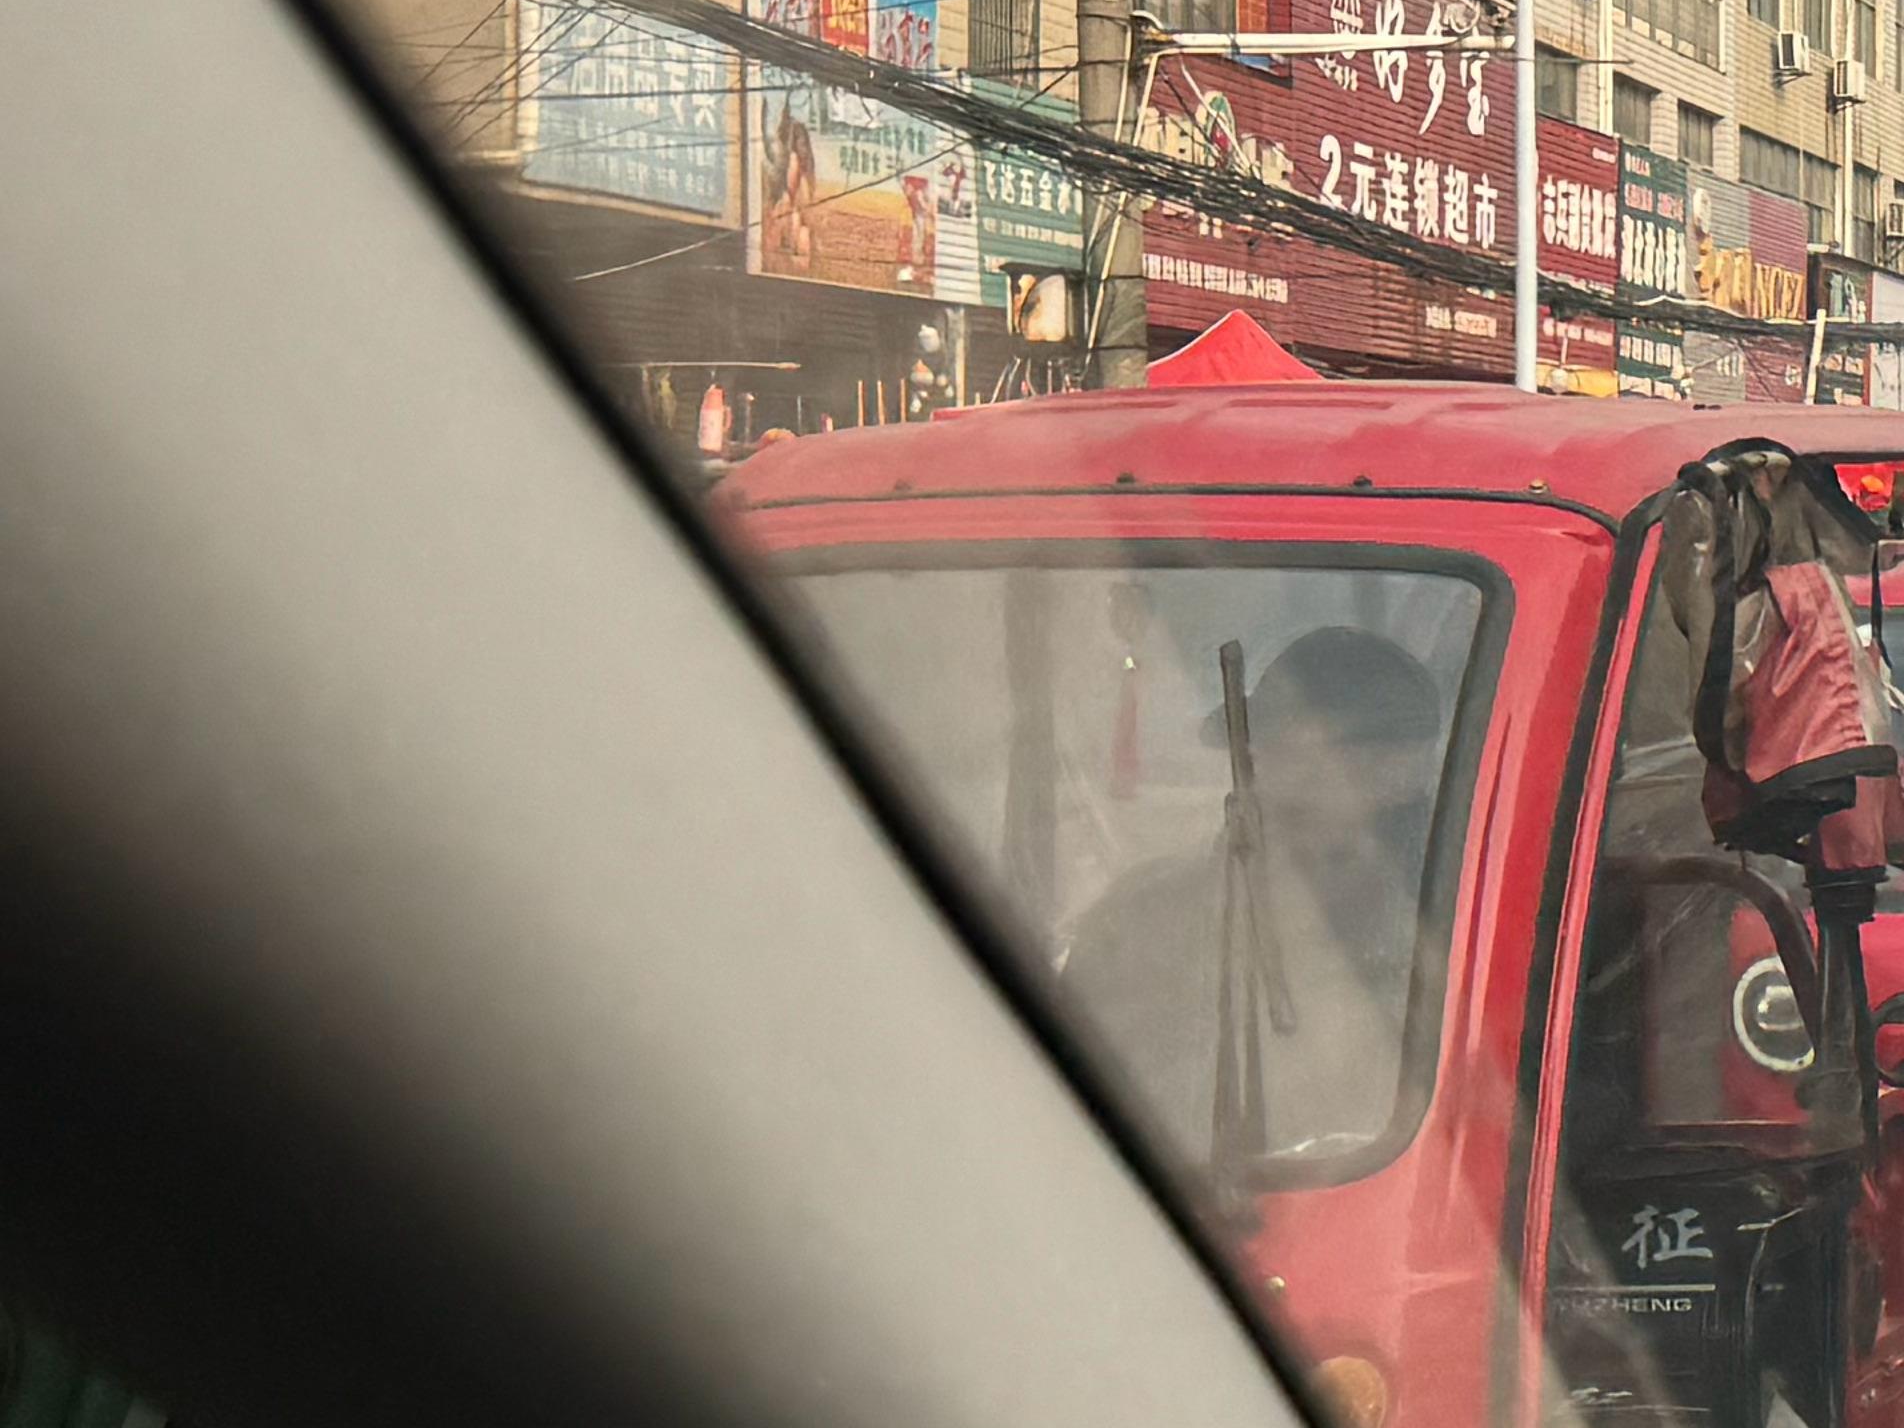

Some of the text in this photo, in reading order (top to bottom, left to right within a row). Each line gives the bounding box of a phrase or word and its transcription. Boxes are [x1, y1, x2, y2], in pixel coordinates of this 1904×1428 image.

[1318, 133, 1499, 250] 2元连锁超市
[1621, 1204, 1714, 1269] 征
